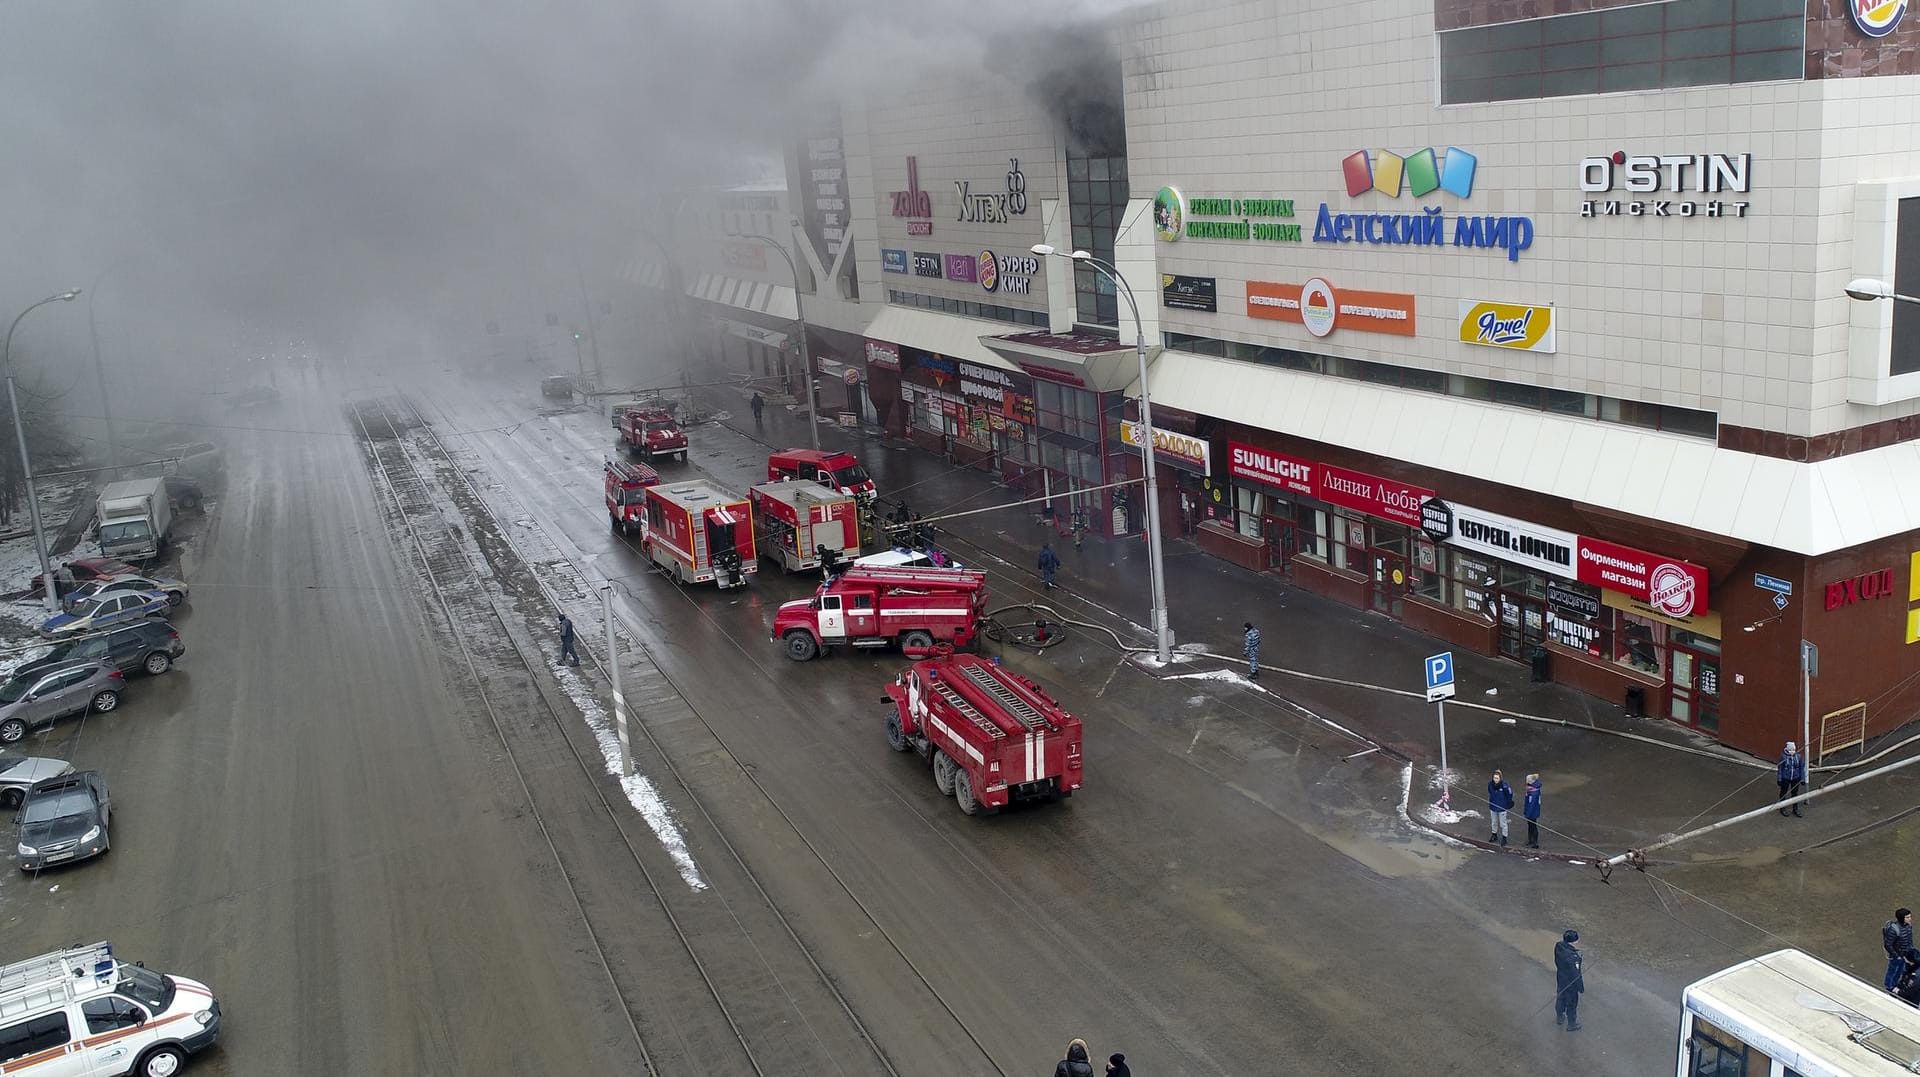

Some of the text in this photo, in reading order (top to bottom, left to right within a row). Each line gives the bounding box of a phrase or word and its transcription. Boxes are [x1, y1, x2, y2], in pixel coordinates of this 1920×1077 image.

[1579, 150, 1751, 193] O'STIN
[890, 156, 932, 218] zolla
[1190, 199, 1295, 217] РЕБЯТАМ О ЗВЕРЯТАХ
[1580, 200, 1750, 218] ДИСКОНТ
[1186, 219, 1302, 242] КОНТАКТНЫЙ ЗООПАРК
[1313, 203, 1534, 262] Детский мир
[951, 257, 968, 276] kari
[981, 265, 995, 281] KING
[1001, 256, 1037, 275] БУРГЕР
[1002, 276, 1030, 294] КИНГ
[1478, 308, 1533, 341] Ярче!
[959, 363, 1015, 387] СУПЕРМАРКЕ
[1233, 448, 1311, 482] SUNLIGHT
[1323, 470, 1421, 513] Линии Любв
[1459, 518, 1570, 566] ЧЕБУРЕКИ & ПОНЧИКИ
[1422, 550, 1432, 562] 70
[1581, 547, 1646, 575] Фирменный
[1601, 570, 1646, 590] магазин
[1825, 568, 1894, 611] ВХОД
[829, 618, 834, 626] 3
[1554, 617, 1593, 640] ПИЦЦЕТТЫ
[1432, 658, 1447, 683] P
[1071, 744, 1076, 754] 7
[990, 762, 1000, 772] АЦ
